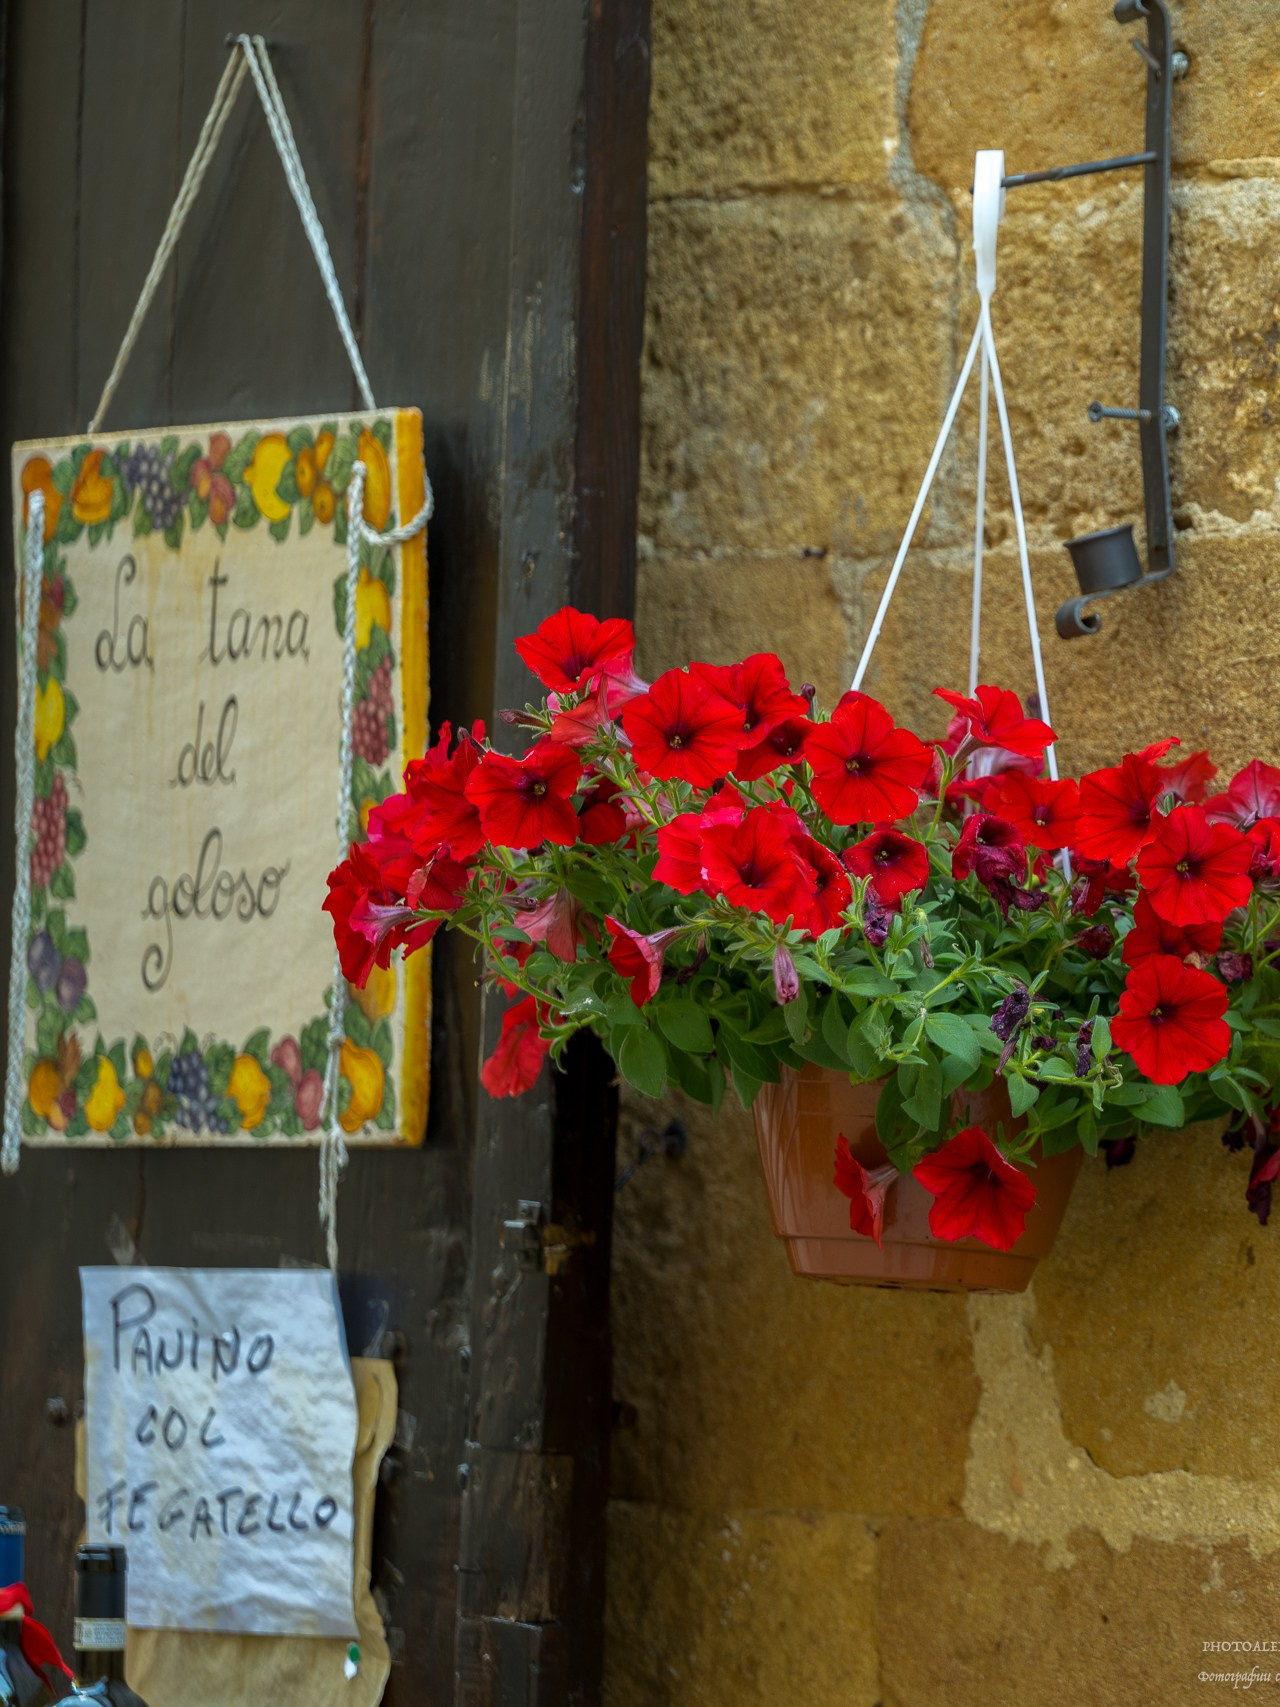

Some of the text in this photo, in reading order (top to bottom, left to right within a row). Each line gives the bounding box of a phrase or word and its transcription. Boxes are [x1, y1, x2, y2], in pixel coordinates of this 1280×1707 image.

[95, 554, 311, 673] La tana
[169, 694, 237, 786] del
[141, 827, 291, 992] goloso
[135, 1405, 226, 1450] COL
[97, 1479, 338, 1541] FEGATELLO
